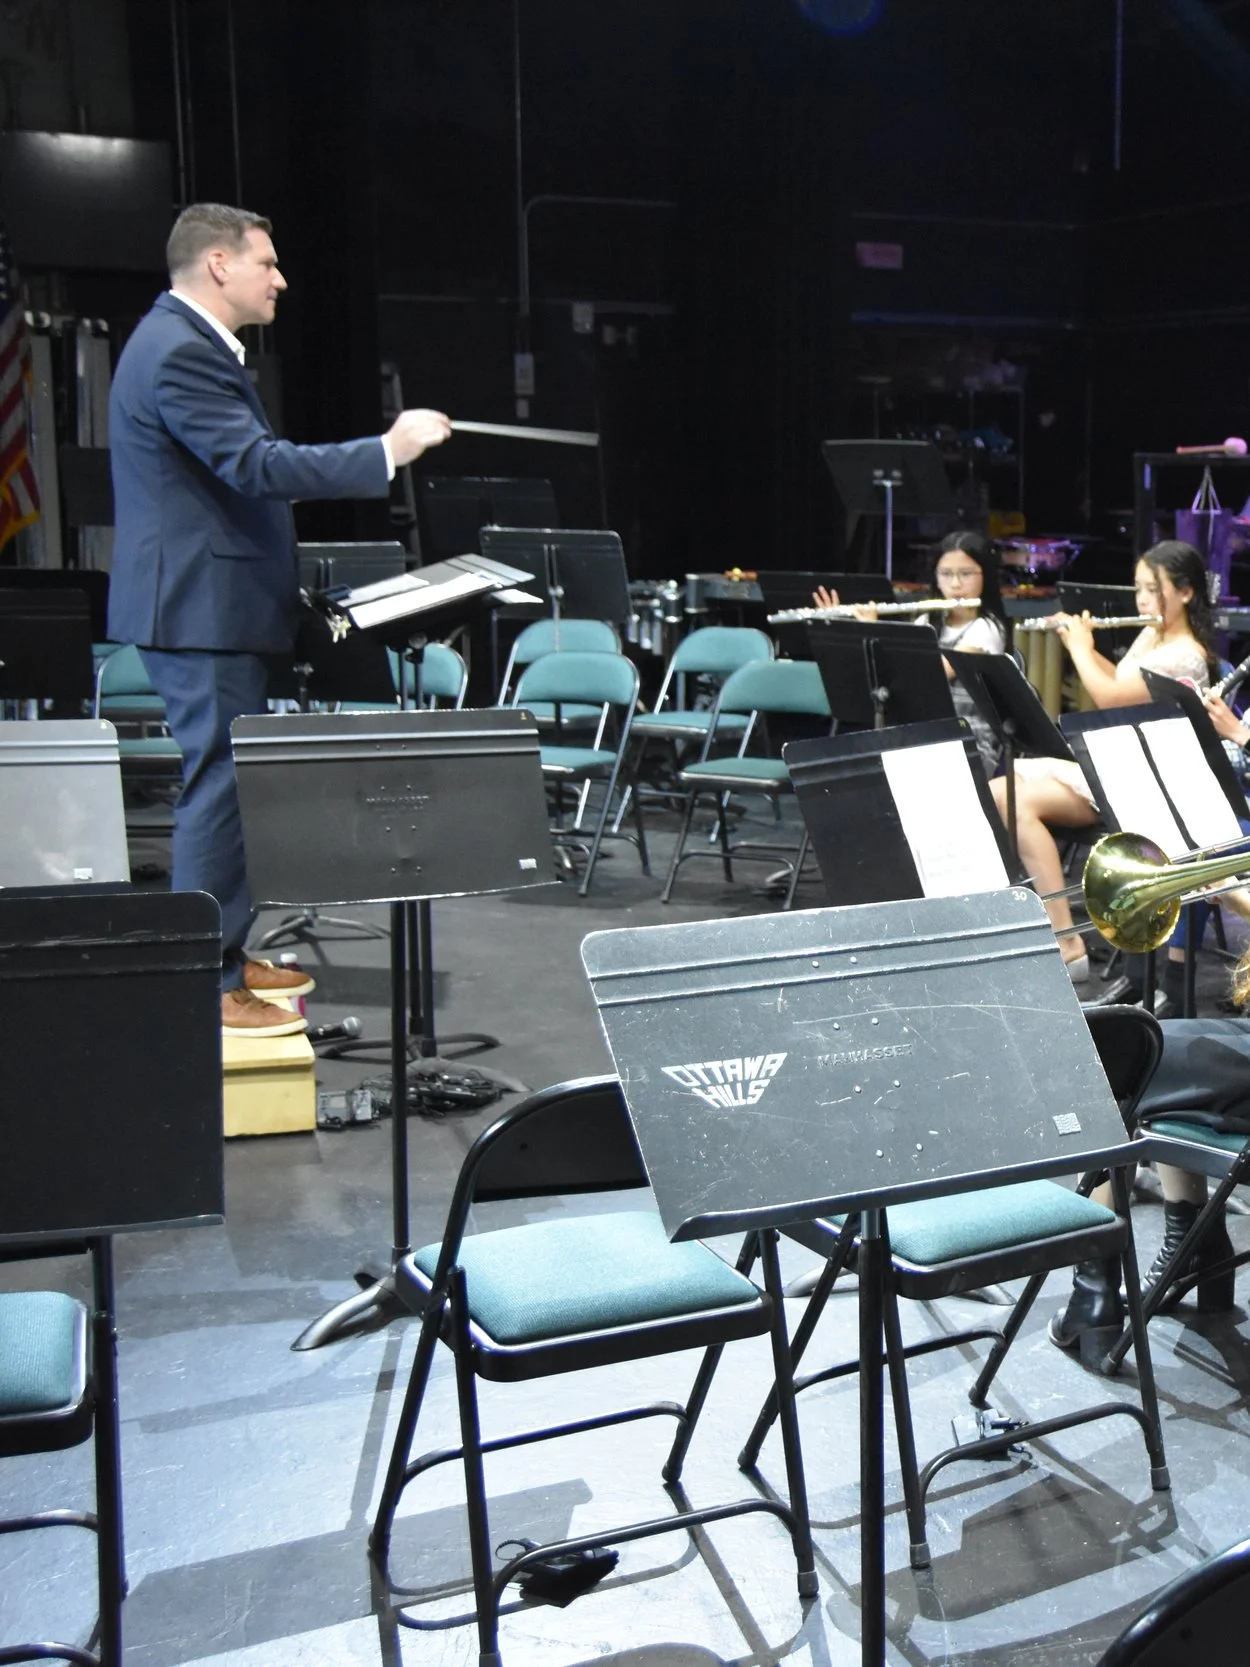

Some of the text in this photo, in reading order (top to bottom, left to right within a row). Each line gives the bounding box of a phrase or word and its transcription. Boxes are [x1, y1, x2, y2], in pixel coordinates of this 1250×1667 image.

[1012, 891, 1027, 901] 30
[660, 1052, 788, 1088] OTTAWA
[691, 1079, 771, 1108] HILLS
